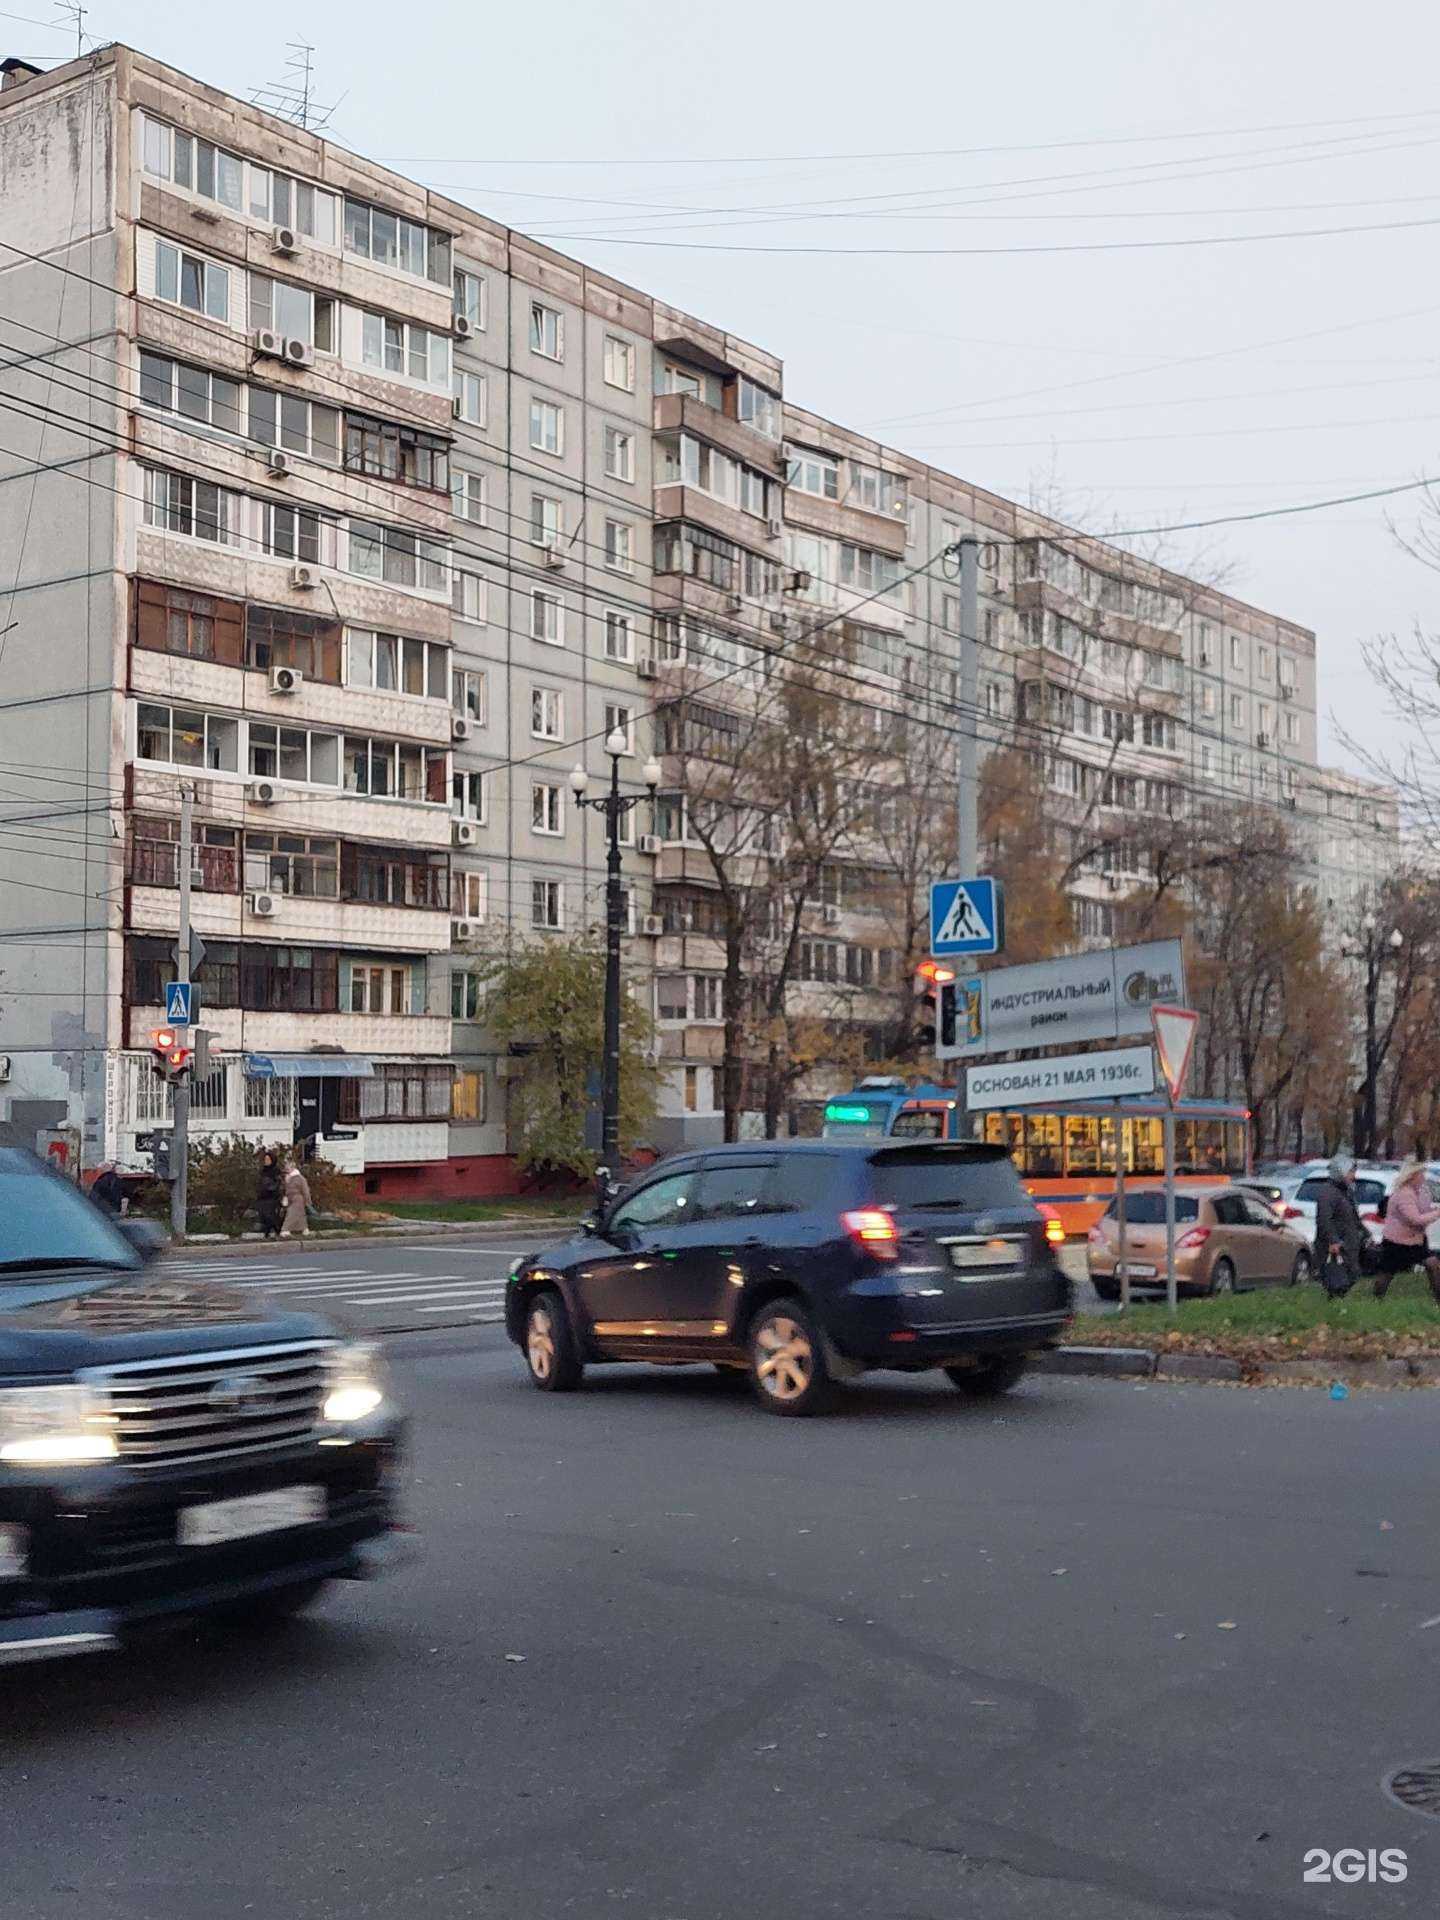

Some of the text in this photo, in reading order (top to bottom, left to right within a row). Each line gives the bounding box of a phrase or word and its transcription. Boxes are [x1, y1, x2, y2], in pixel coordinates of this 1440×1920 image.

[991, 978, 1111, 1011] ИНДУСТРИАЛЬНЫЙ
[972, 1063, 1142, 1094] ОСНОВАН 21 МАЯ 1936г.
